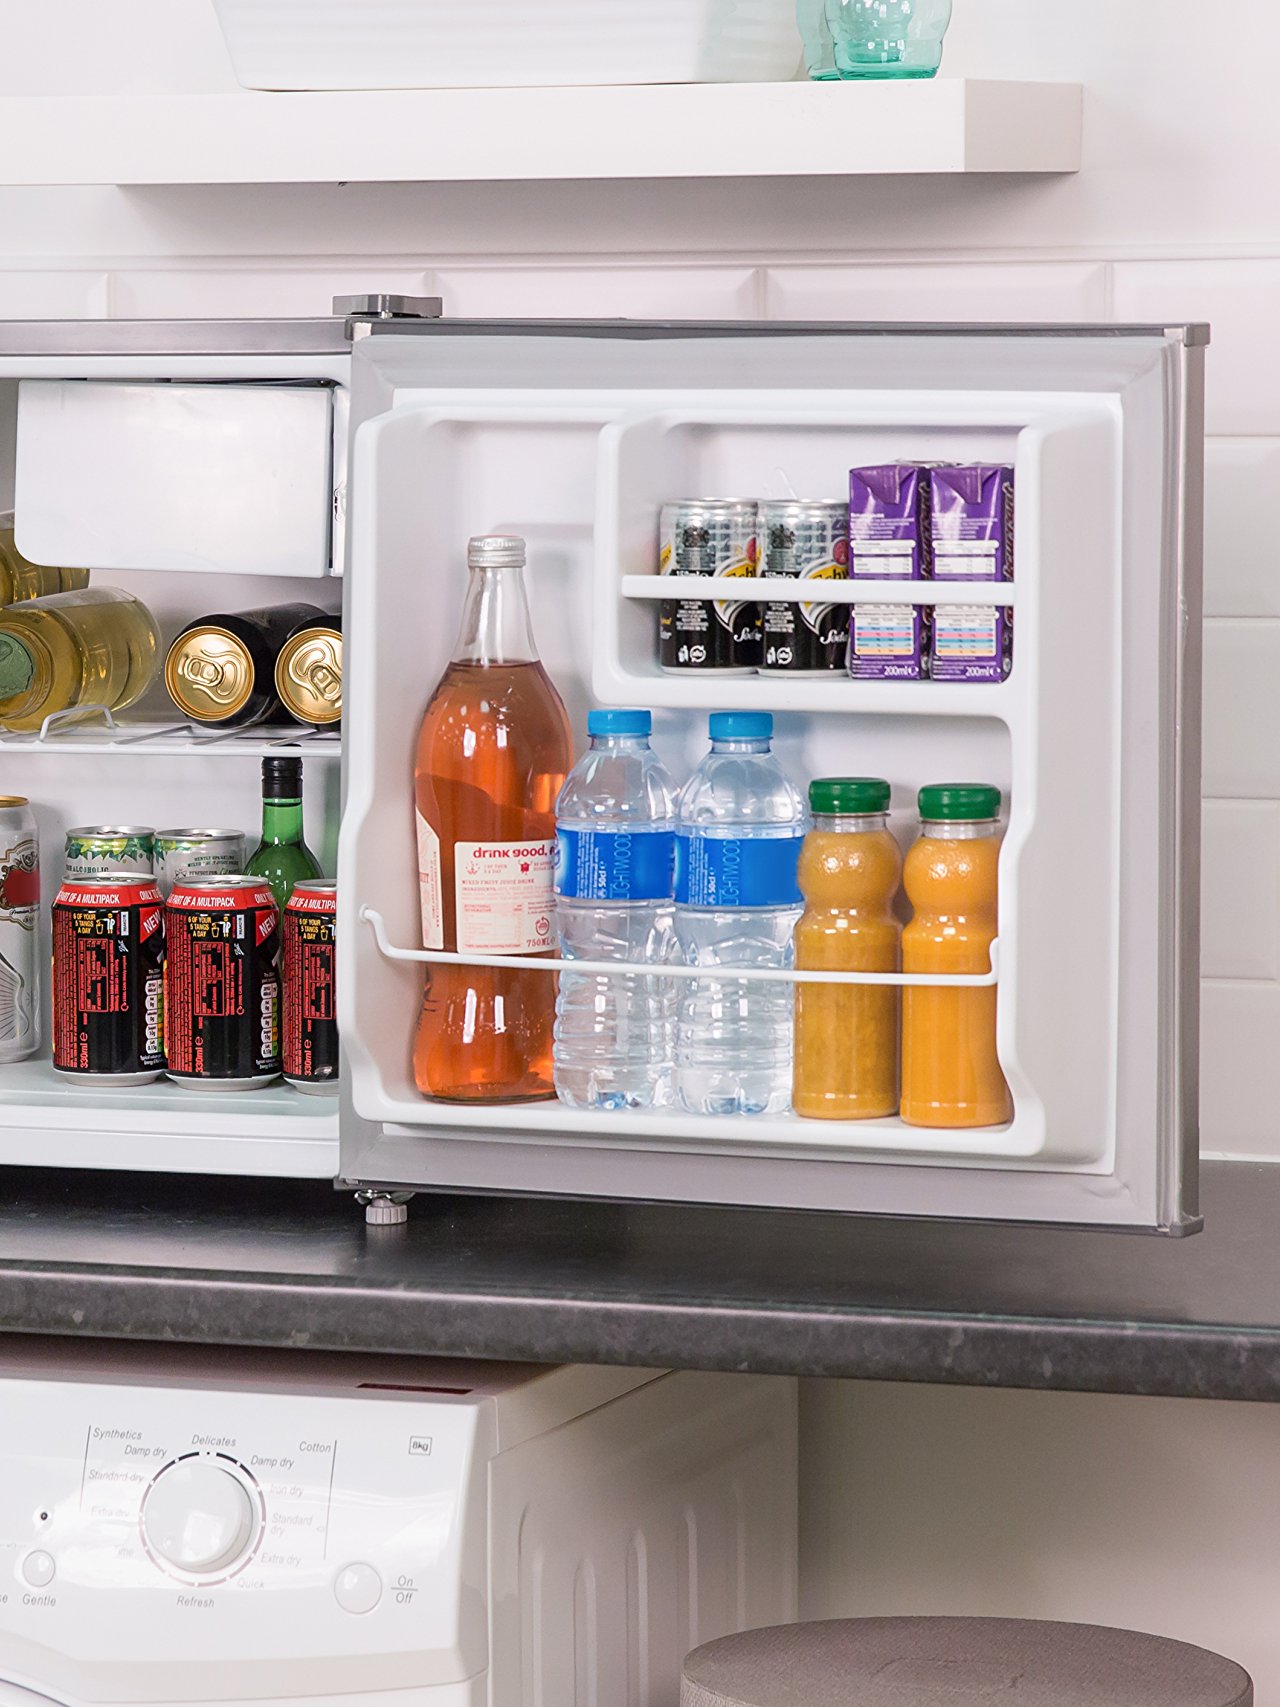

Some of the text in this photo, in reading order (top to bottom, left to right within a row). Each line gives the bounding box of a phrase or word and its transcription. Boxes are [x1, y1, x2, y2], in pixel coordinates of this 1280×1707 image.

[884, 665, 908, 676] 200ml
[965, 666, 990, 677] 200ml
[473, 844, 548, 859] drink good.
[598, 869, 607, 888] 50cl
[81, 894, 120, 904] MULTIPACK
[196, 896, 236, 907] MULTIPACK
[308, 899, 337, 910] MULTIPA
[83, 913, 96, 921] YOUR
[143, 910, 161, 934] NEW
[192, 916, 199, 924] OF
[198, 916, 212, 924] YOUR
[309, 919, 321, 927] YOUR
[258, 914, 276, 937] NEW
[197, 930, 207, 938] DAY
[307, 932, 317, 940] DAY
[80, 1043, 89, 1069] 330ml
[195, 1047, 204, 1073] 330ml
[304, 1050, 312, 1076] 330ml
[93, 1427, 143, 1441] Synthetics
[191, 1434, 237, 1447] Delicates
[124, 1444, 168, 1459] Damp dry
[299, 1441, 332, 1453] Cotton
[250, 1455, 295, 1470] Damp dry
[88, 1469, 144, 1484] Standard dry
[289, 1485, 304, 1497] dry
[272, 1513, 313, 1526] Standard
[271, 1525, 285, 1536] dry
[260, 1553, 302, 1566] Extra dry
[397, 1575, 414, 1587] On
[22, 1593, 57, 1607] Gentle
[176, 1595, 215, 1608] Refresh
[395, 1591, 413, 1604] Off
